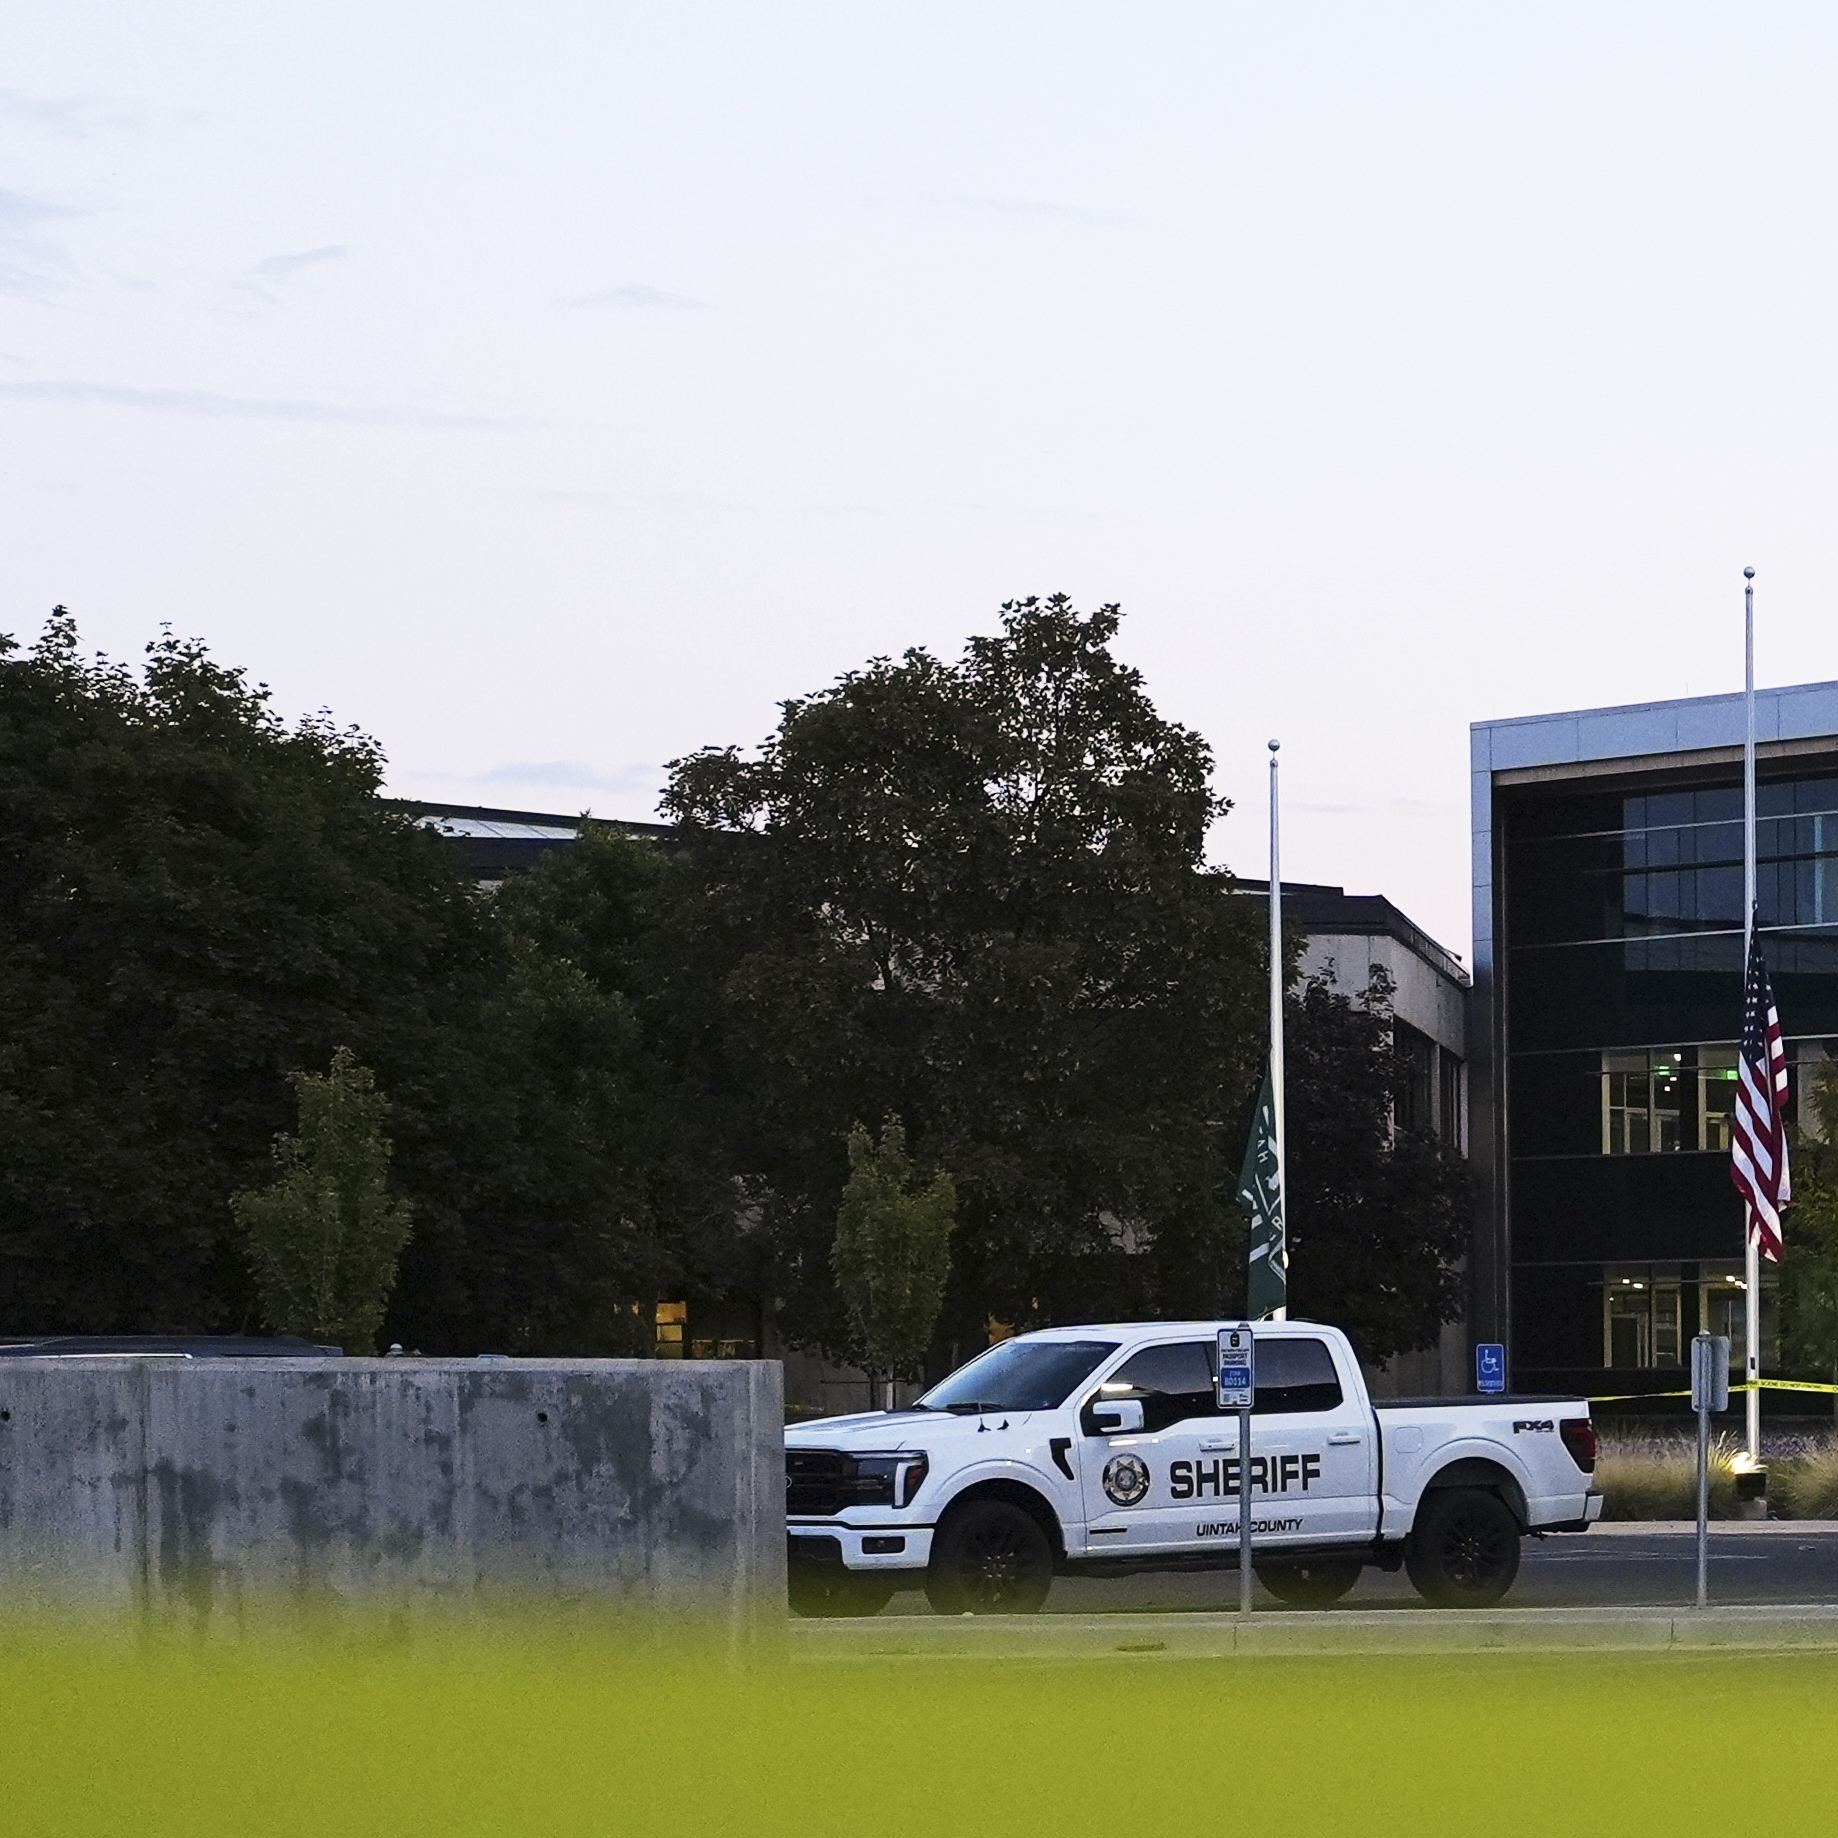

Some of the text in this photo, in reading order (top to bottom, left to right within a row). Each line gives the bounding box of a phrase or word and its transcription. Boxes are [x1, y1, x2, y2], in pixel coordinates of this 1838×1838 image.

[1512, 1419, 1555, 1434] FX4
[1170, 1453, 1321, 1500] SHERIFF
[1250, 1518, 1304, 1534] COUNTY
